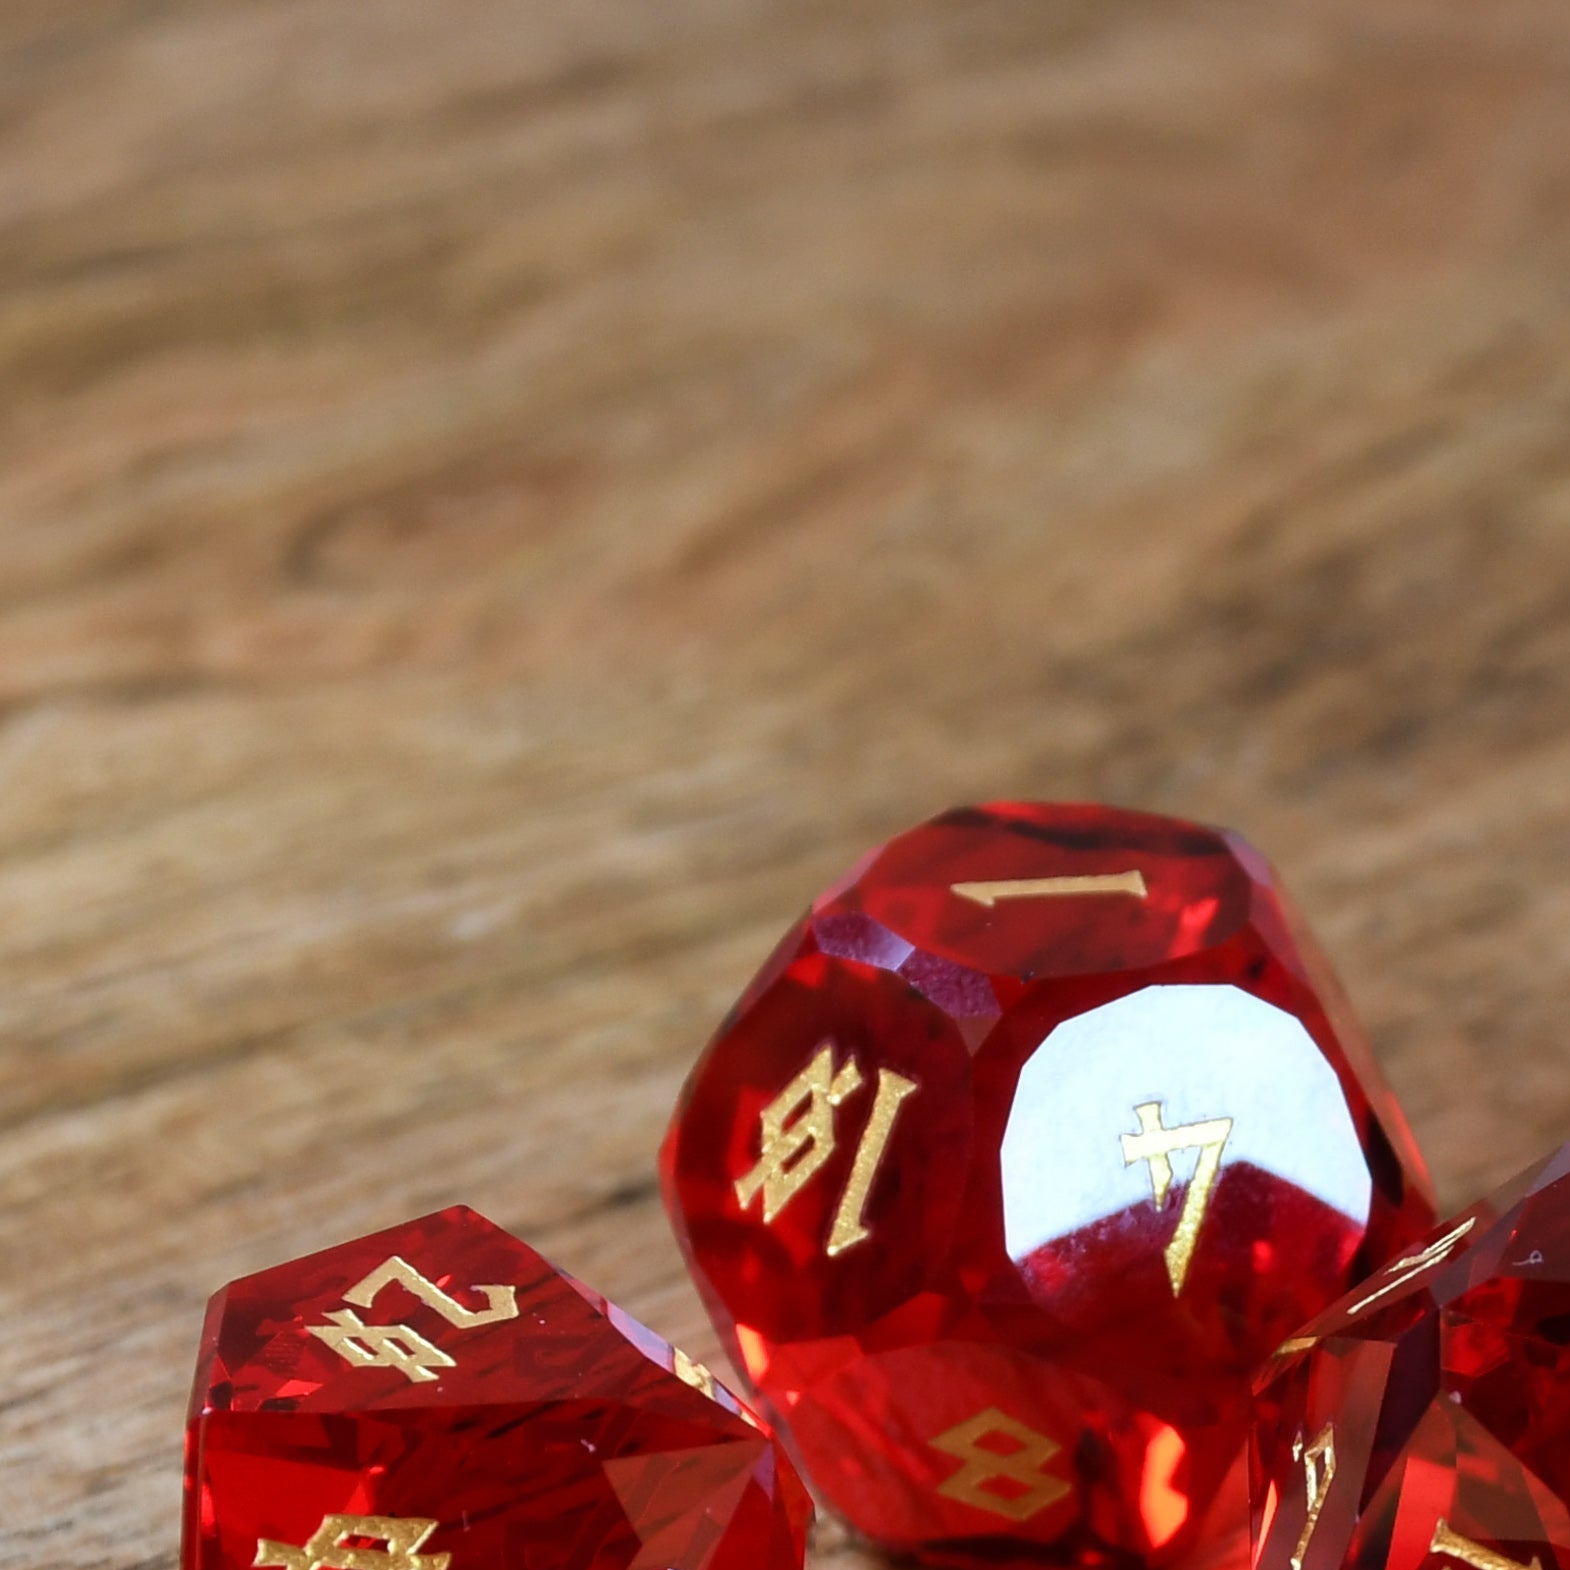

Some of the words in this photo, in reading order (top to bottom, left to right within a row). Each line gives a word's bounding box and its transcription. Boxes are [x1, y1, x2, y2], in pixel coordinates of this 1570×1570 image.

[954, 871, 1147, 906] 1
[1121, 1101, 1233, 1298] 4
[928, 1406, 1072, 1522] 8
